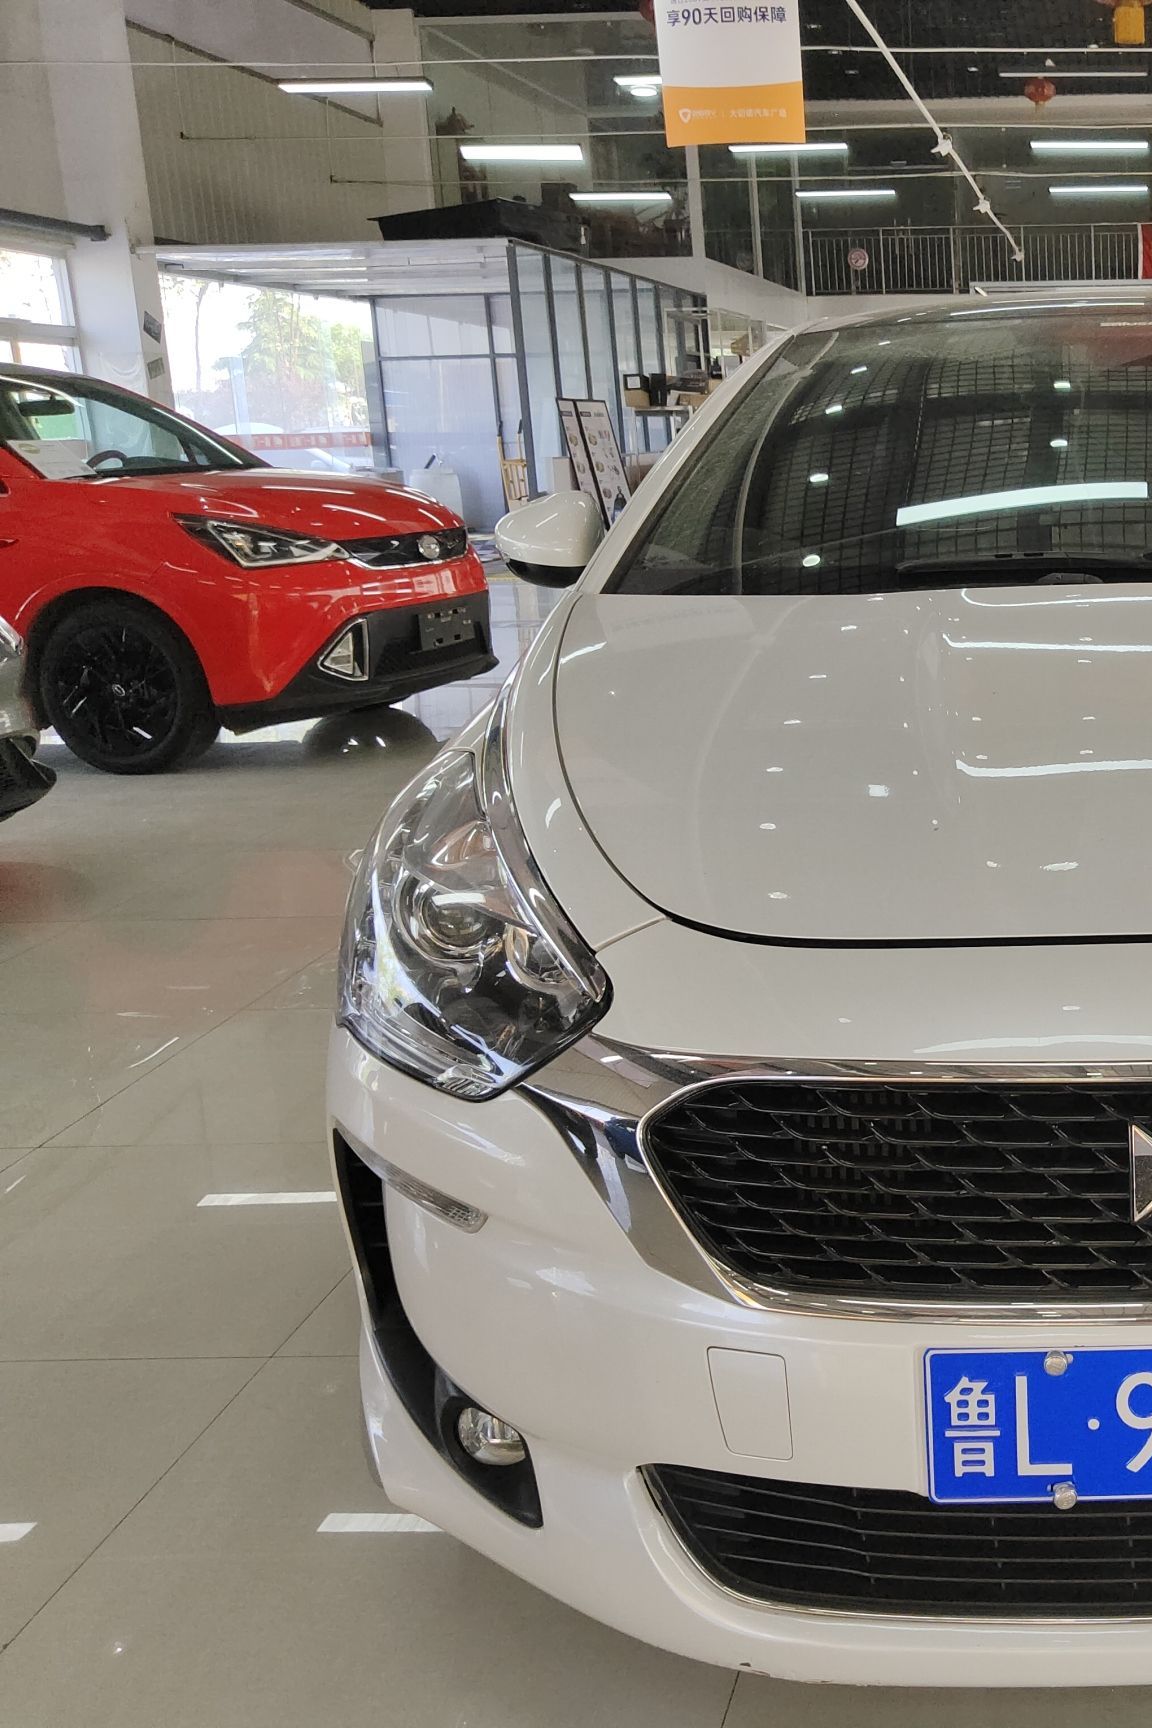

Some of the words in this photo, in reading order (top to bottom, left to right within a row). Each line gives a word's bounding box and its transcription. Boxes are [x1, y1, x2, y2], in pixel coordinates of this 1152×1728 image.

[666, 6, 787, 26] 享90天回购保障
